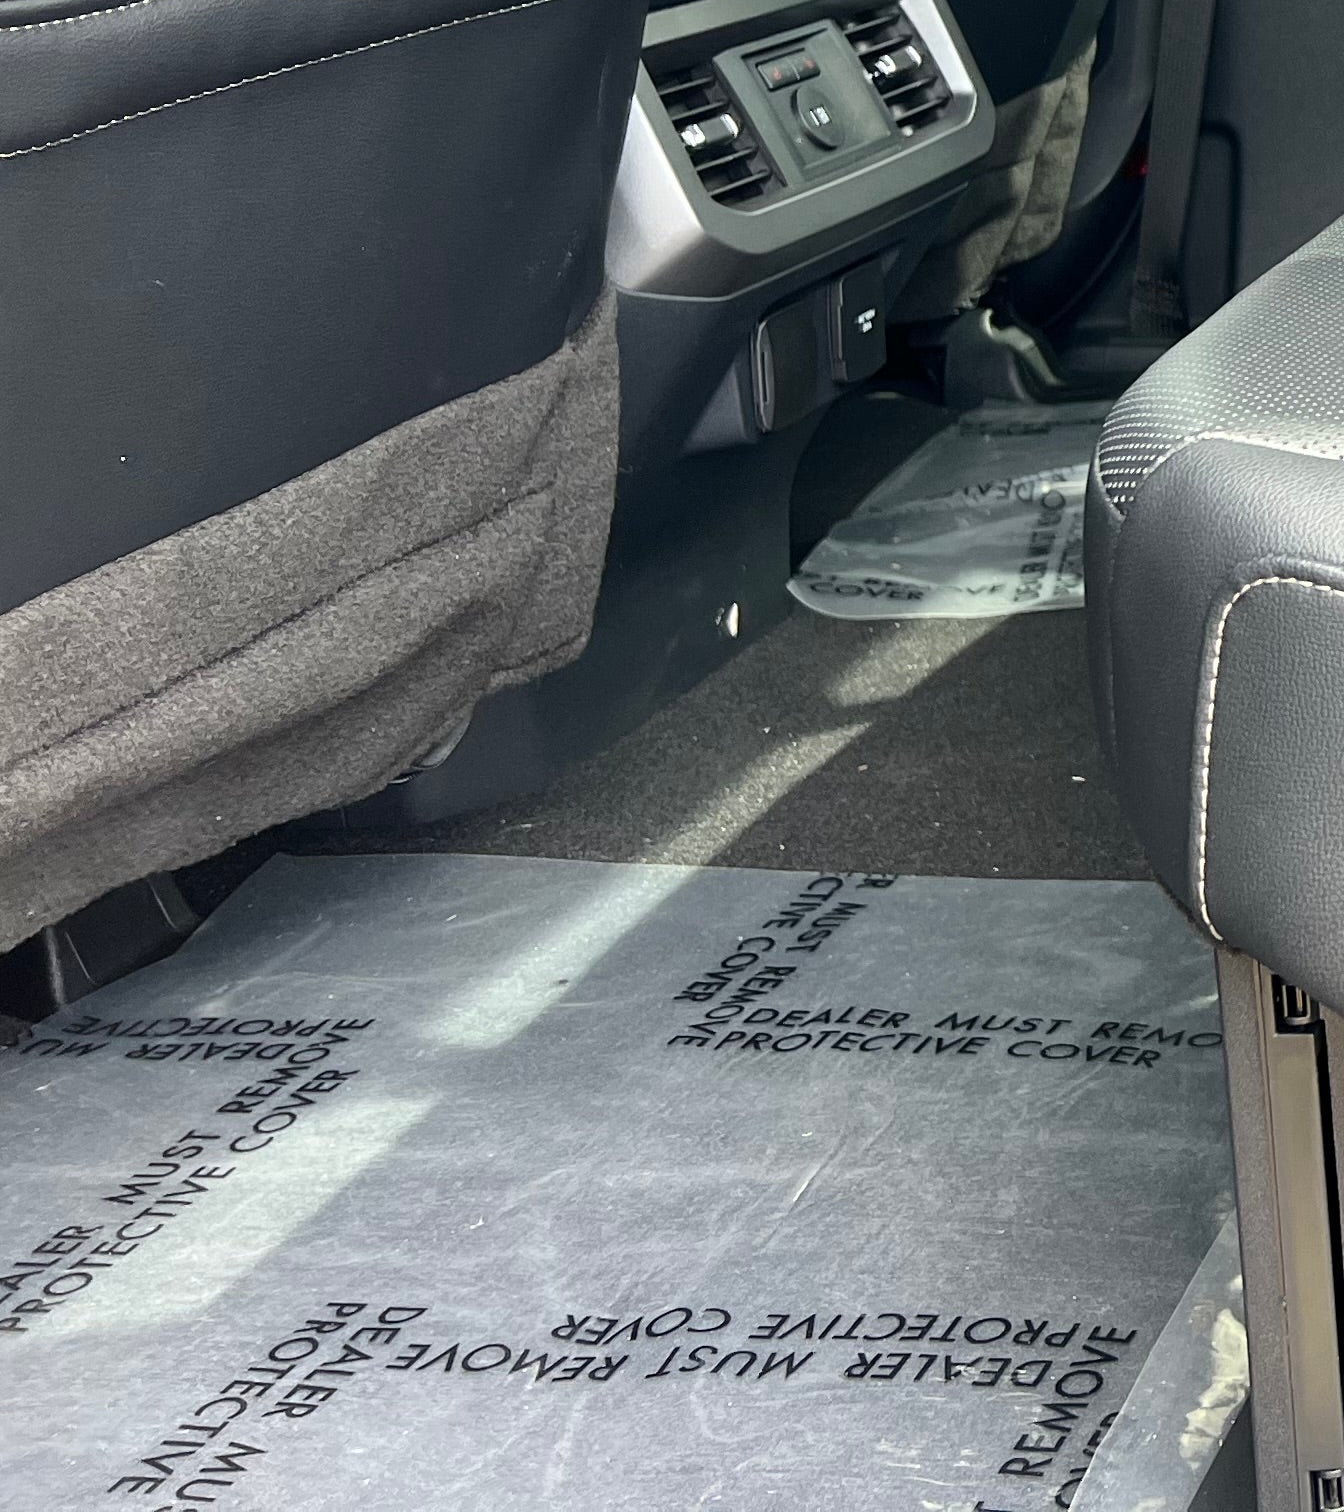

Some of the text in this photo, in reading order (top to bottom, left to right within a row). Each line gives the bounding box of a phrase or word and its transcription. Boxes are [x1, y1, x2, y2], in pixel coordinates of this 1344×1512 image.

[667, 902, 868, 1047] MUST REMOVE
[673, 874, 844, 1002] CTIVE COVER
[62, 1015, 331, 1037] PROTECTIVE
[124, 1041, 296, 1061] DEALER
[714, 1030, 1162, 1069] PROTECTIVE COVER
[743, 1006, 911, 1029] DEALER
[934, 1012, 1072, 1035] MUST
[0, 1019, 375, 1304] ALER MUST REMOVE
[0, 1070, 361, 1332] PROTECTIVE COVER
[385, 1343, 1053, 1387] DEALER MUST REMOVE
[552, 1307, 1081, 1348] PROTECTIVE COVER
[106, 1302, 368, 1494] PROTECTIVE
[154, 1306, 428, 1512] DEALER MU
[998, 1325, 1138, 1477] REMOVE
